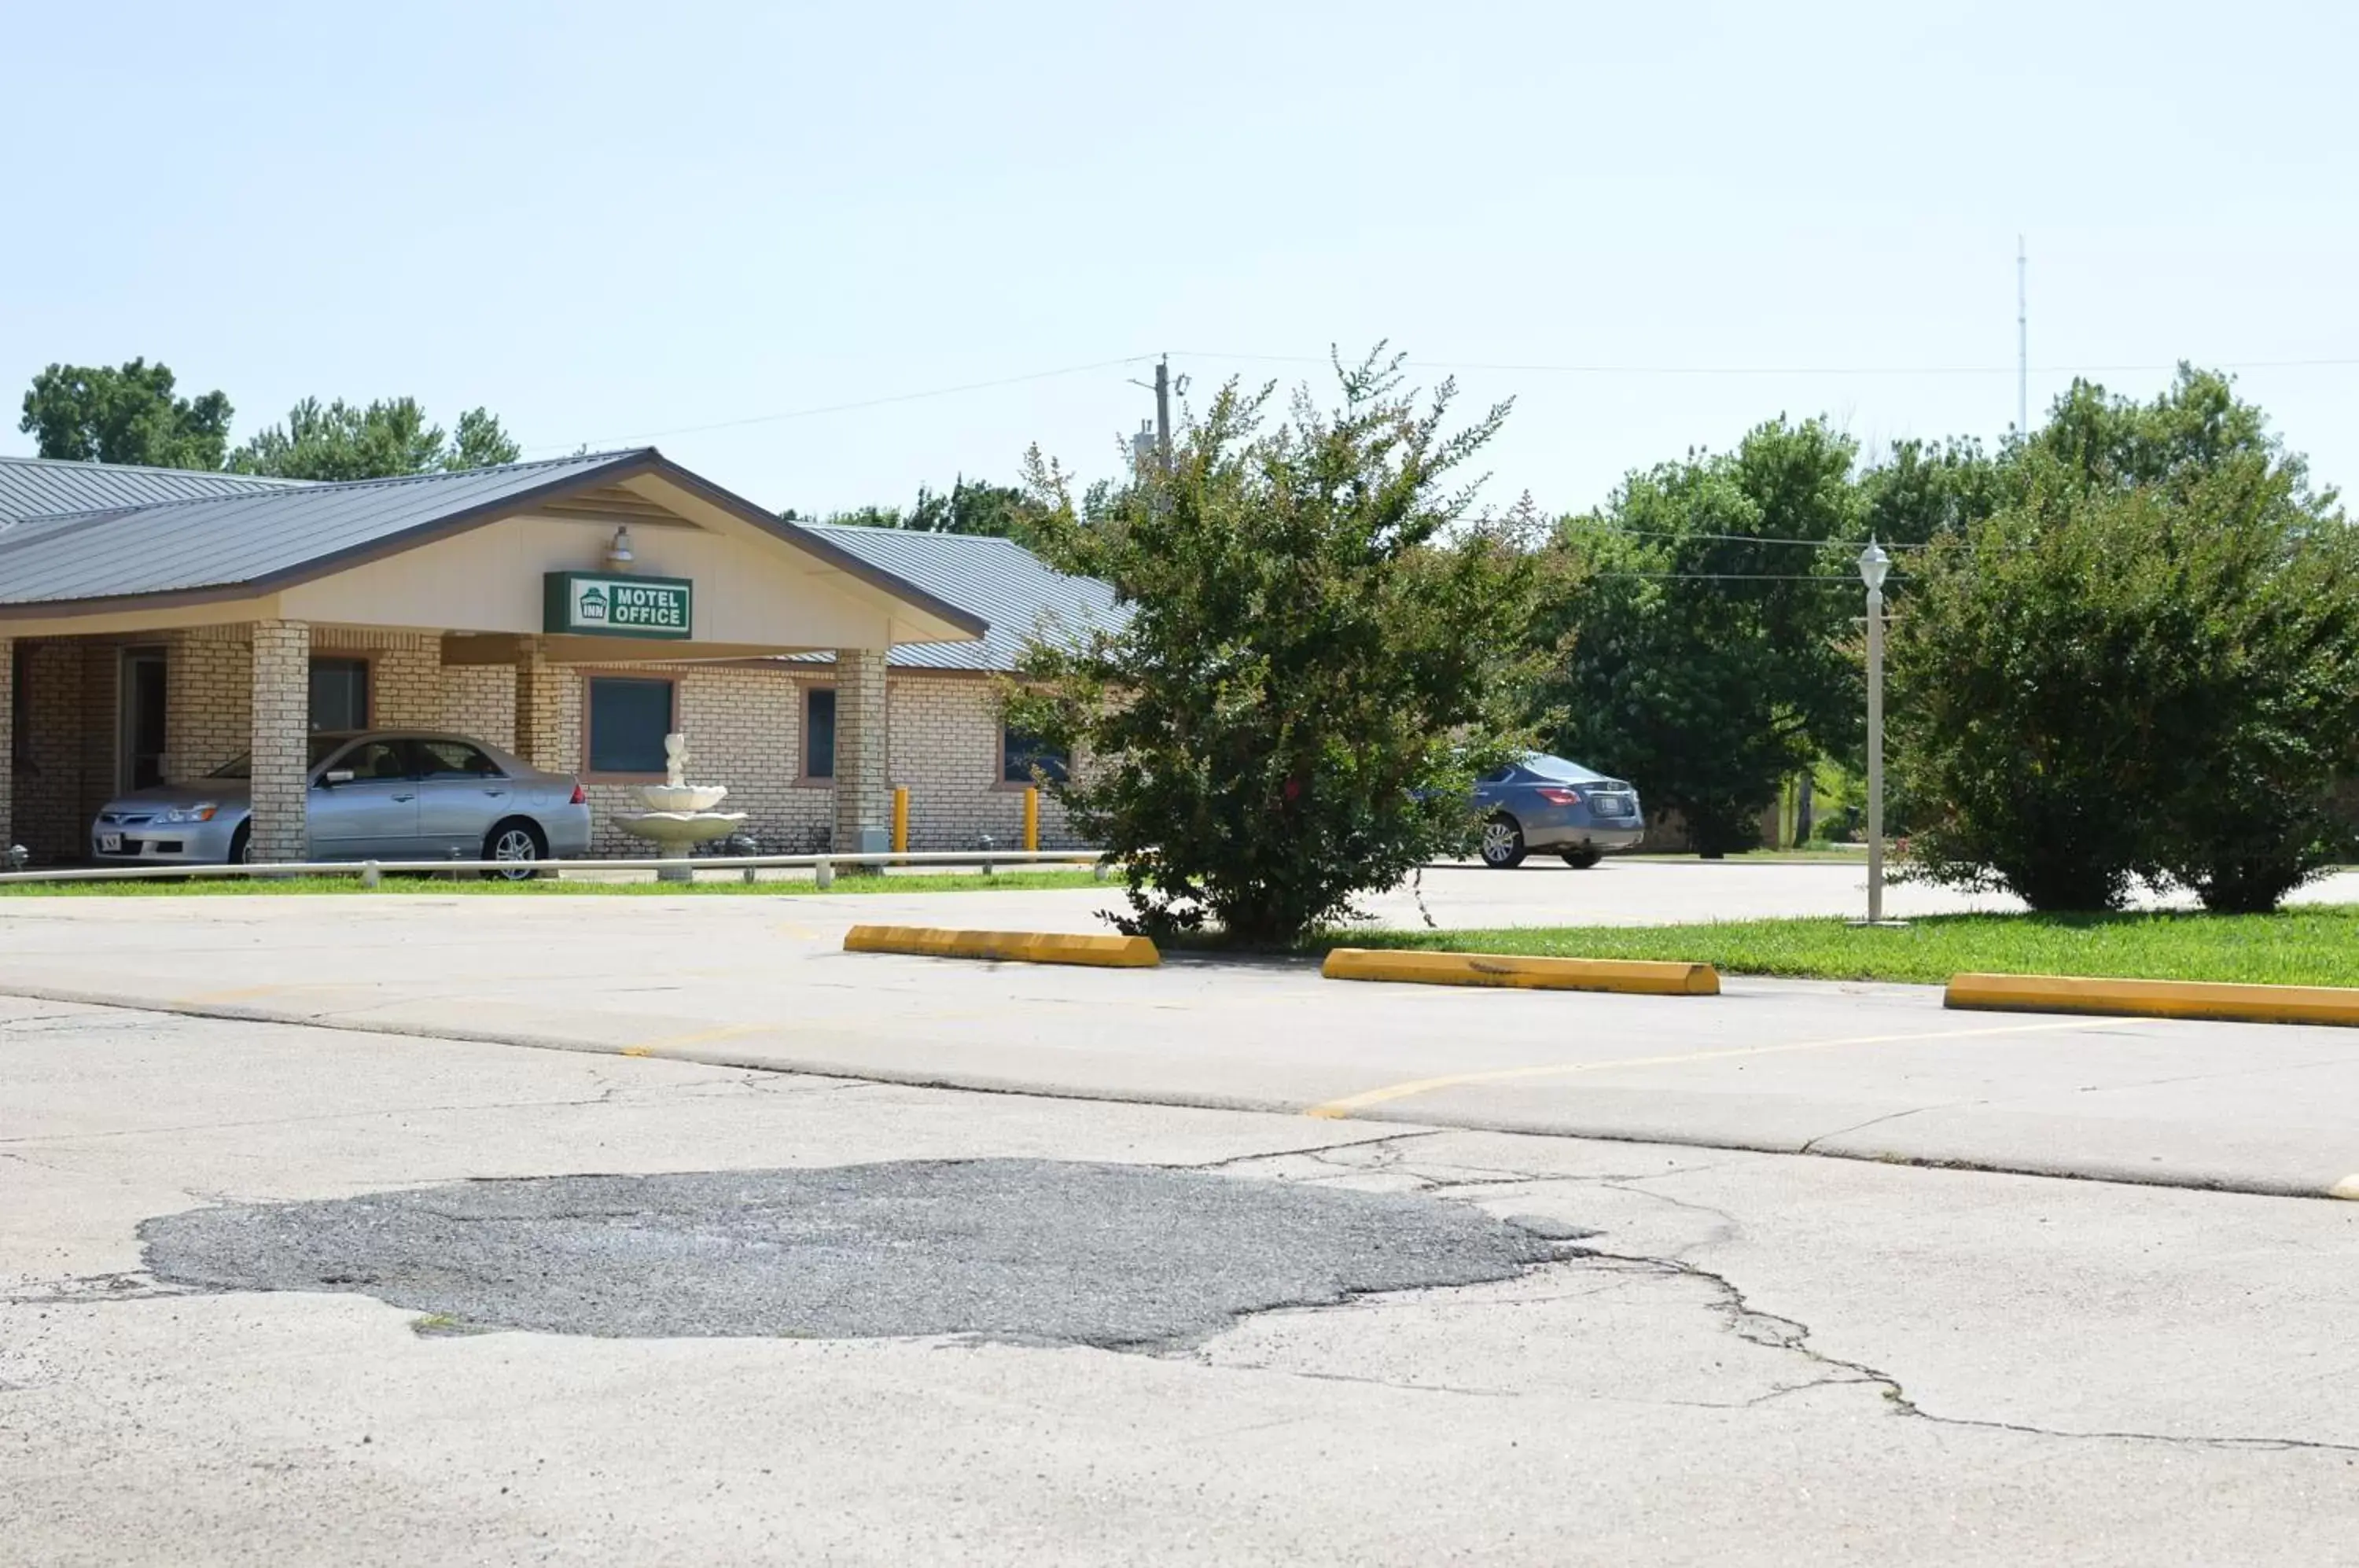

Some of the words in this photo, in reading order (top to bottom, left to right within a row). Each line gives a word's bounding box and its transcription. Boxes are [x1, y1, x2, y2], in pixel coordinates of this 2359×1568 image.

[617, 588, 678, 607] MOTEL
[583, 605, 603, 617] INN
[616, 606, 680, 624] OFFICE
